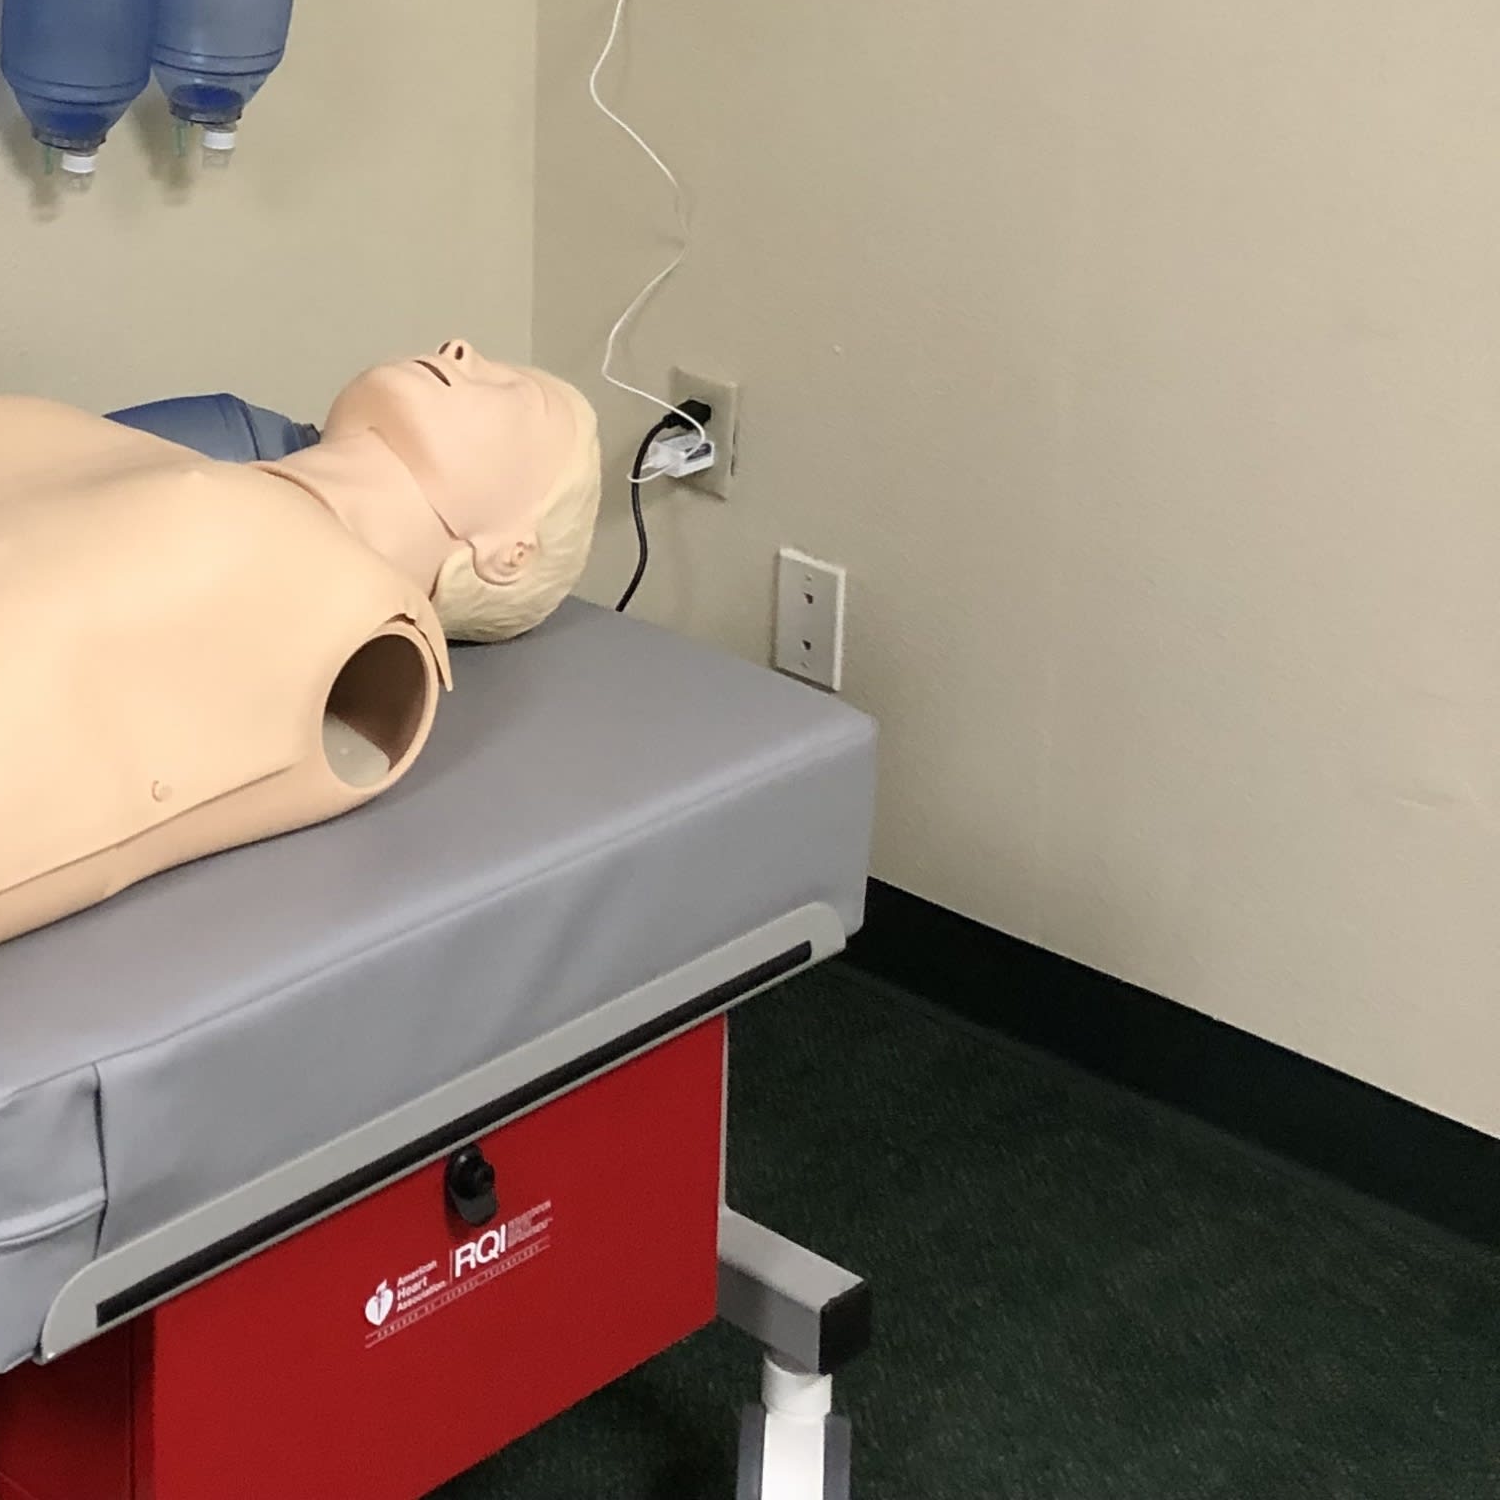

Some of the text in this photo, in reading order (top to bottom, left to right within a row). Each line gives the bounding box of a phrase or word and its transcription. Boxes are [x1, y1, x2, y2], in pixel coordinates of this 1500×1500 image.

[454, 1223, 507, 1278] RQI
[396, 1259, 438, 1288] American
[396, 1275, 428, 1300] Heart
